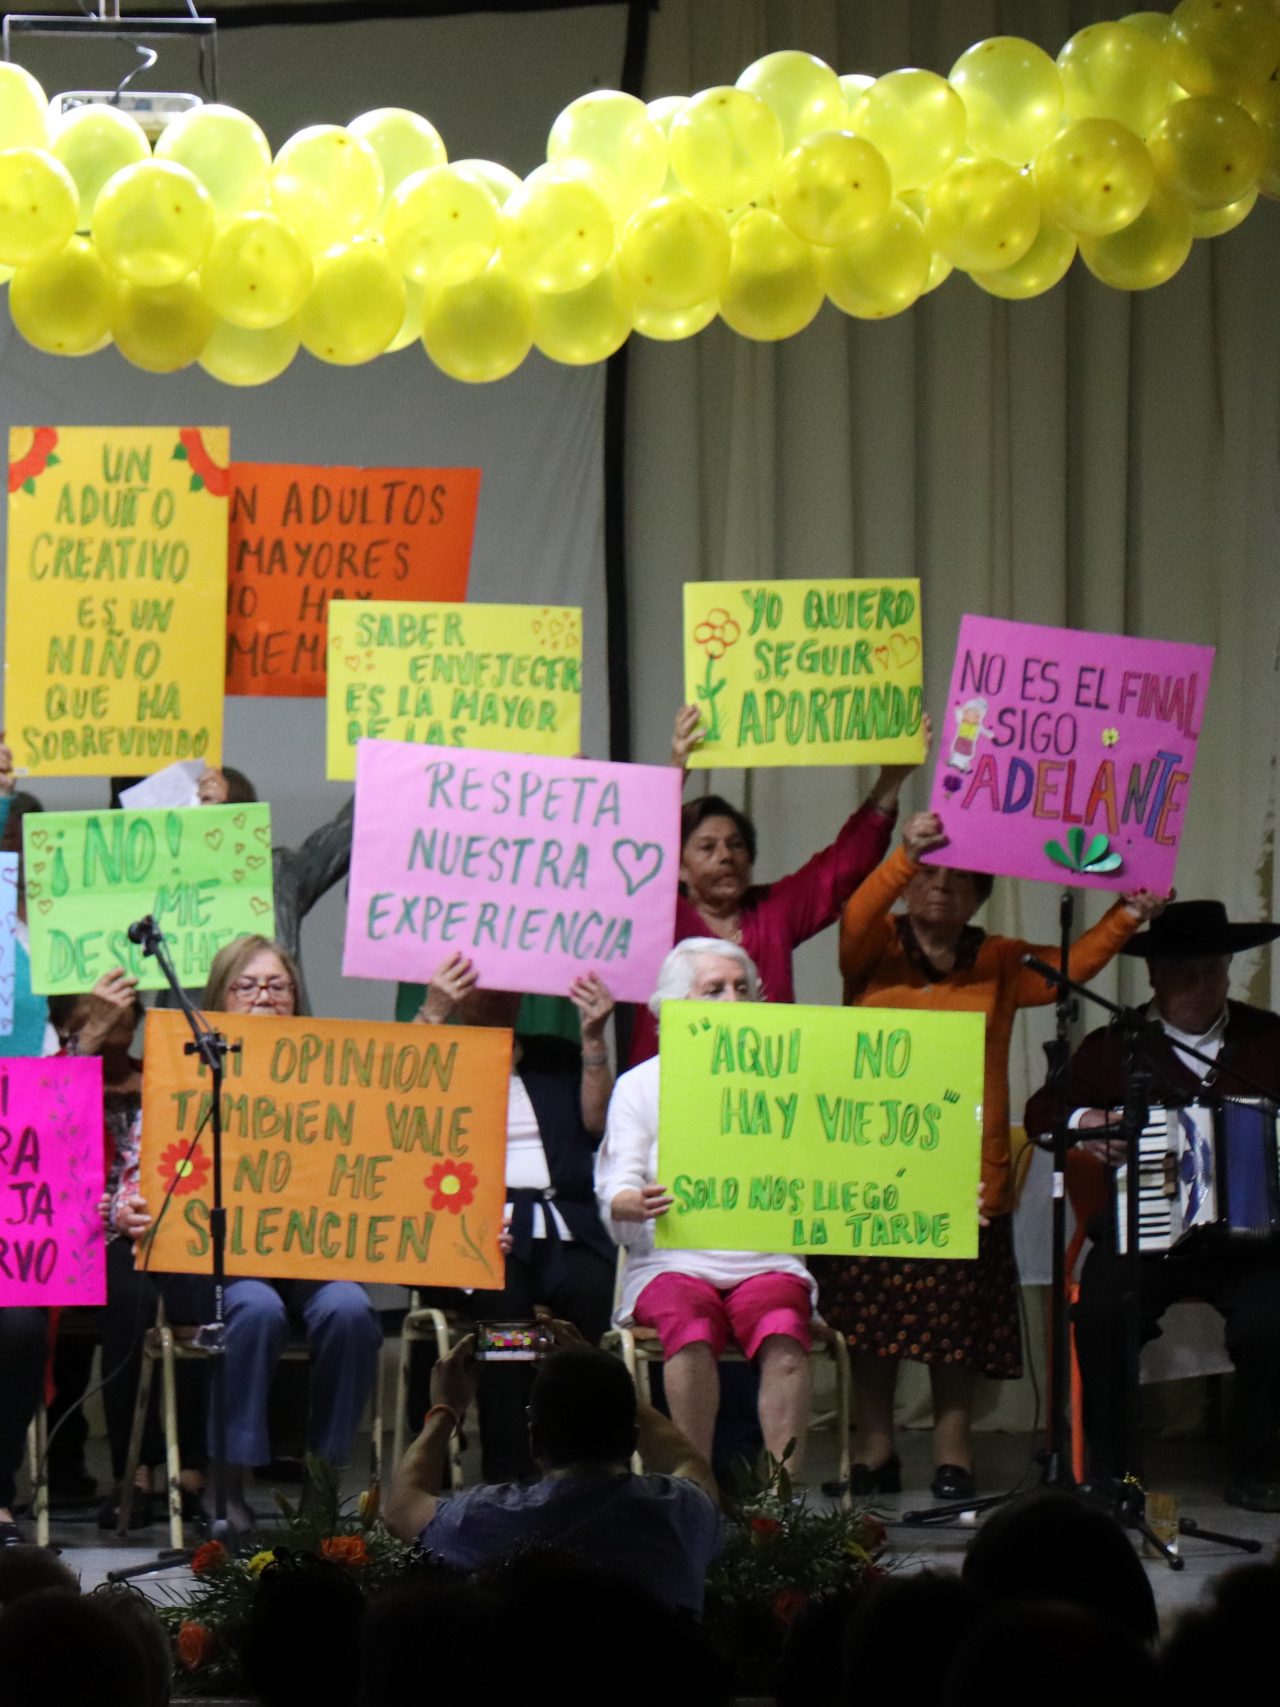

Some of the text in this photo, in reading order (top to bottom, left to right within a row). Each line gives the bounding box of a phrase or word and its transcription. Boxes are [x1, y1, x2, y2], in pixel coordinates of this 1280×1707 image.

[101, 444, 152, 484] UN
[281, 482, 446, 528] ADULTOS
[28, 530, 190, 583] CREATIVO
[235, 537, 412, 580] MAYORES
[77, 597, 174, 633] ES UN
[356, 612, 465, 650] SABER
[741, 589, 915, 636] YO QUIERO
[47, 627, 162, 680] NIÑO
[754, 639, 874, 682] SEGUIR
[46, 682, 181, 722] QUE HA
[346, 684, 559, 733] ES LA MAYOR
[737, 682, 923, 749] APORTANDO
[960, 649, 1200, 742] NO ES EL FINAL
[23, 725, 210, 766] SOBREVIVIDO
[991, 707, 1078, 757] SIGO
[423, 761, 621, 826] RESPETA
[961, 750, 1190, 847] ADELANTE
[408, 827, 589, 889] NUESTRA
[154, 878, 222, 928] ME
[367, 893, 633, 962] EXPERIENCIA
[271, 1034, 459, 1093] OPINION
[854, 1028, 911, 1079] NO
[387, 1104, 472, 1157] VALE
[720, 1088, 798, 1139] HAY
[234, 1149, 394, 1200] NO ME
[673, 1175, 738, 1216] SOLO
[748, 1175, 804, 1215] NOS
[184, 1199, 436, 1263] SLENCIEN
[793, 1212, 951, 1248] LA TARDE
